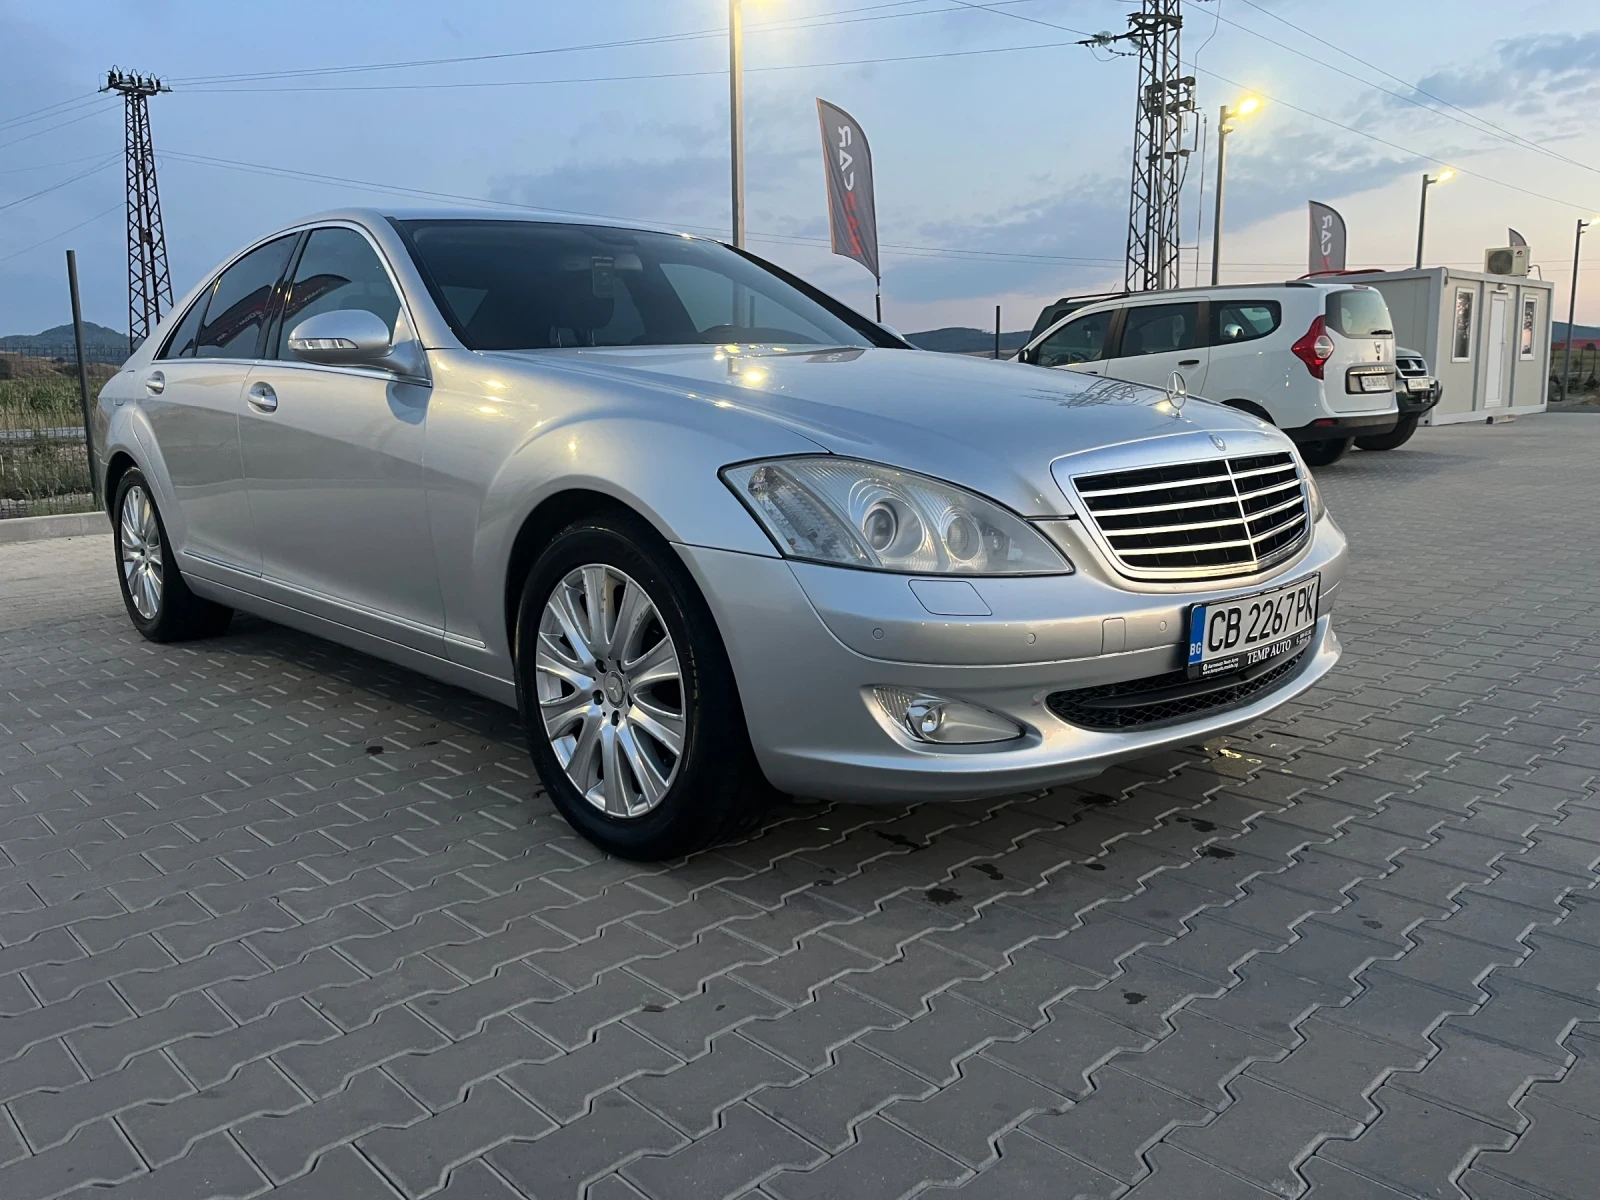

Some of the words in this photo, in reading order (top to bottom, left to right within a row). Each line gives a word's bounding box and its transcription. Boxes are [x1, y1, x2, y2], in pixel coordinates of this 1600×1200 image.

[1208, 606, 1242, 652] CB
[1244, 591, 1295, 645] 2267
[1295, 582, 1314, 627] PK
[1189, 642, 1202, 656] BG
[1247, 648, 1271, 664] TEMP
[1270, 639, 1291, 656] AUTO
